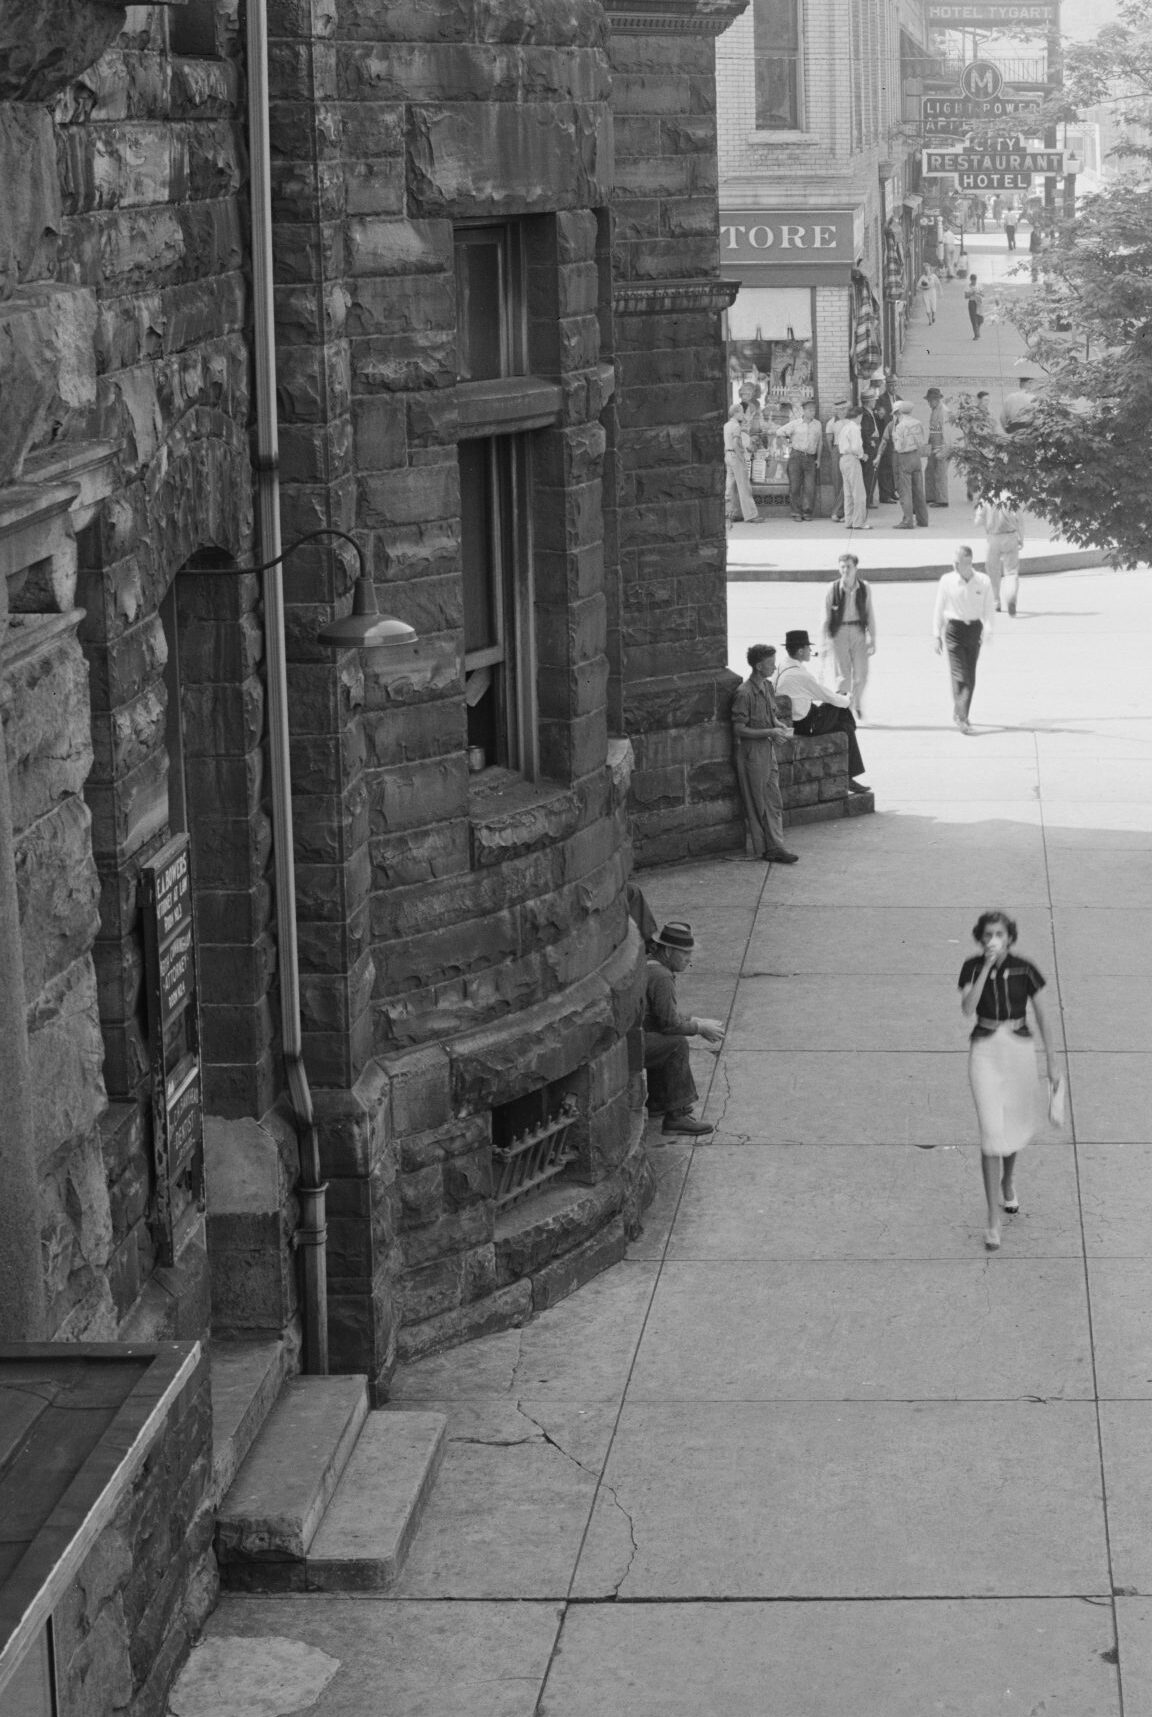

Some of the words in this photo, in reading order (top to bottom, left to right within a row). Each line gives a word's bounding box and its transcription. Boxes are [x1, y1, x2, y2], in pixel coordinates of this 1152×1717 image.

[929, 6, 983, 19] HOTEL
[930, 155, 1061, 171] RESTAURANT
[963, 174, 1028, 188] HOTEL
[720, 225, 837, 249] TORE
